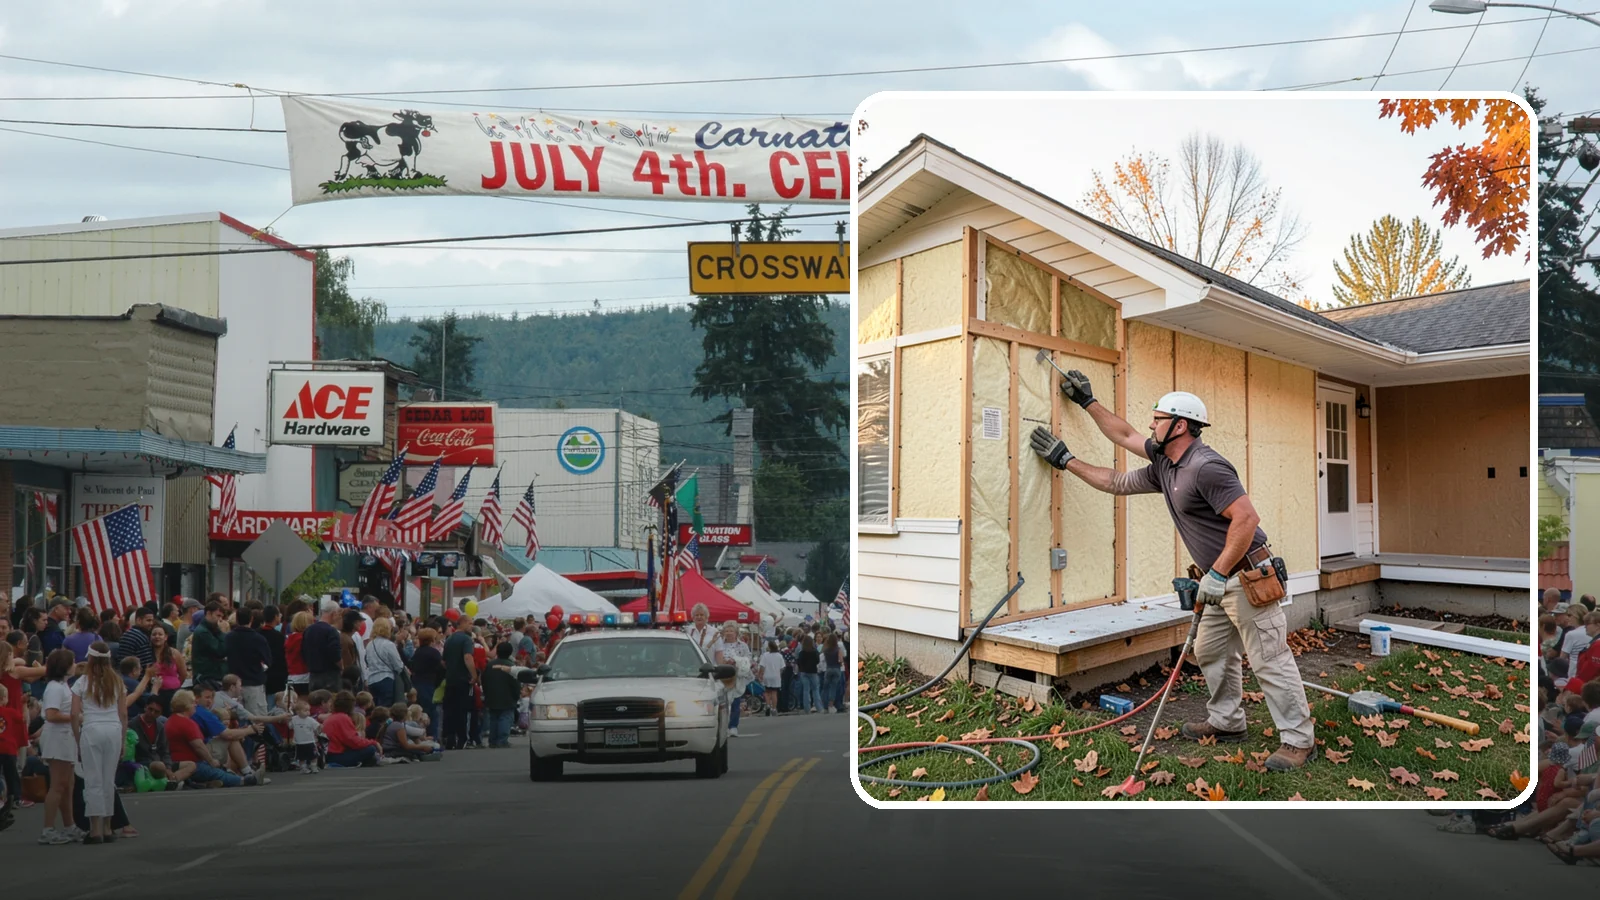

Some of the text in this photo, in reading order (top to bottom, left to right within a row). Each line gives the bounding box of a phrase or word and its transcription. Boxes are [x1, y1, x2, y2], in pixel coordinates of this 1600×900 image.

[481, 140, 605, 192] JULY
[632, 150, 746, 198] 4th.
[697, 254, 850, 280] CROSSWA
[282, 380, 373, 420] ACE
[405, 409, 453, 422] CEDAR
[283, 421, 371, 436] Hardware
[416, 428, 477, 447] Coca-Cola
[353, 467, 386, 481] Simpl
[96, 485, 124, 495] Vincent
[126, 486, 135, 495] de
[137, 486, 155, 495] Paul
[81, 503, 154, 522] THT
[212, 516, 330, 536] HARDARE
[688, 526, 741, 535] CRNATION
[699, 535, 730, 543] GLASS
